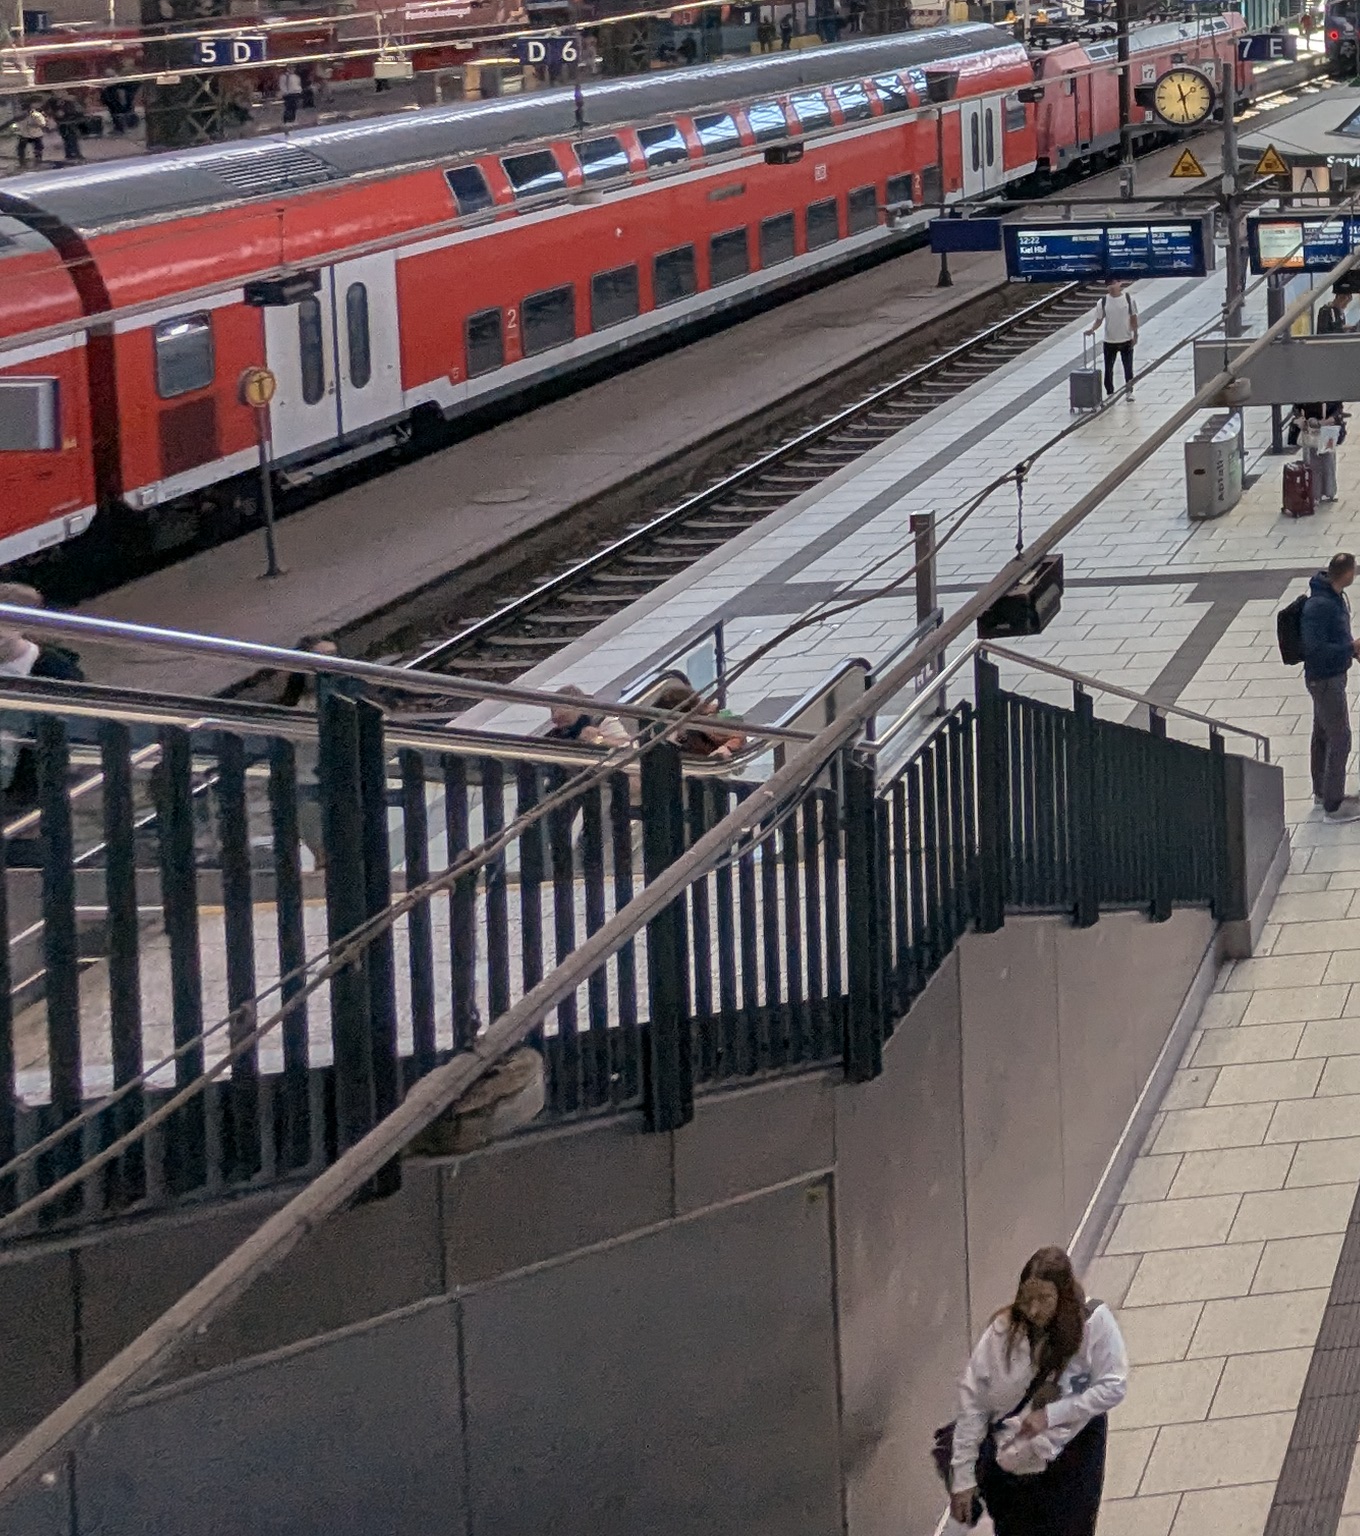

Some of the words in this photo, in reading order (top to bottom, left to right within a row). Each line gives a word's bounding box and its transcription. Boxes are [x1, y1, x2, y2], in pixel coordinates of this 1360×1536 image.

[202, 41, 216, 62] 5
[234, 42, 250, 62] D
[528, 41, 545, 62] D
[562, 40, 577, 62] 6
[1239, 38, 1253, 58] 7
[1270, 38, 1284, 58] E
[1020, 246, 1033, 254] Kiel
[1034, 245, 1047, 253] Hbf
[507, 309, 517, 329] 2
[252, 375, 269, 400] T
